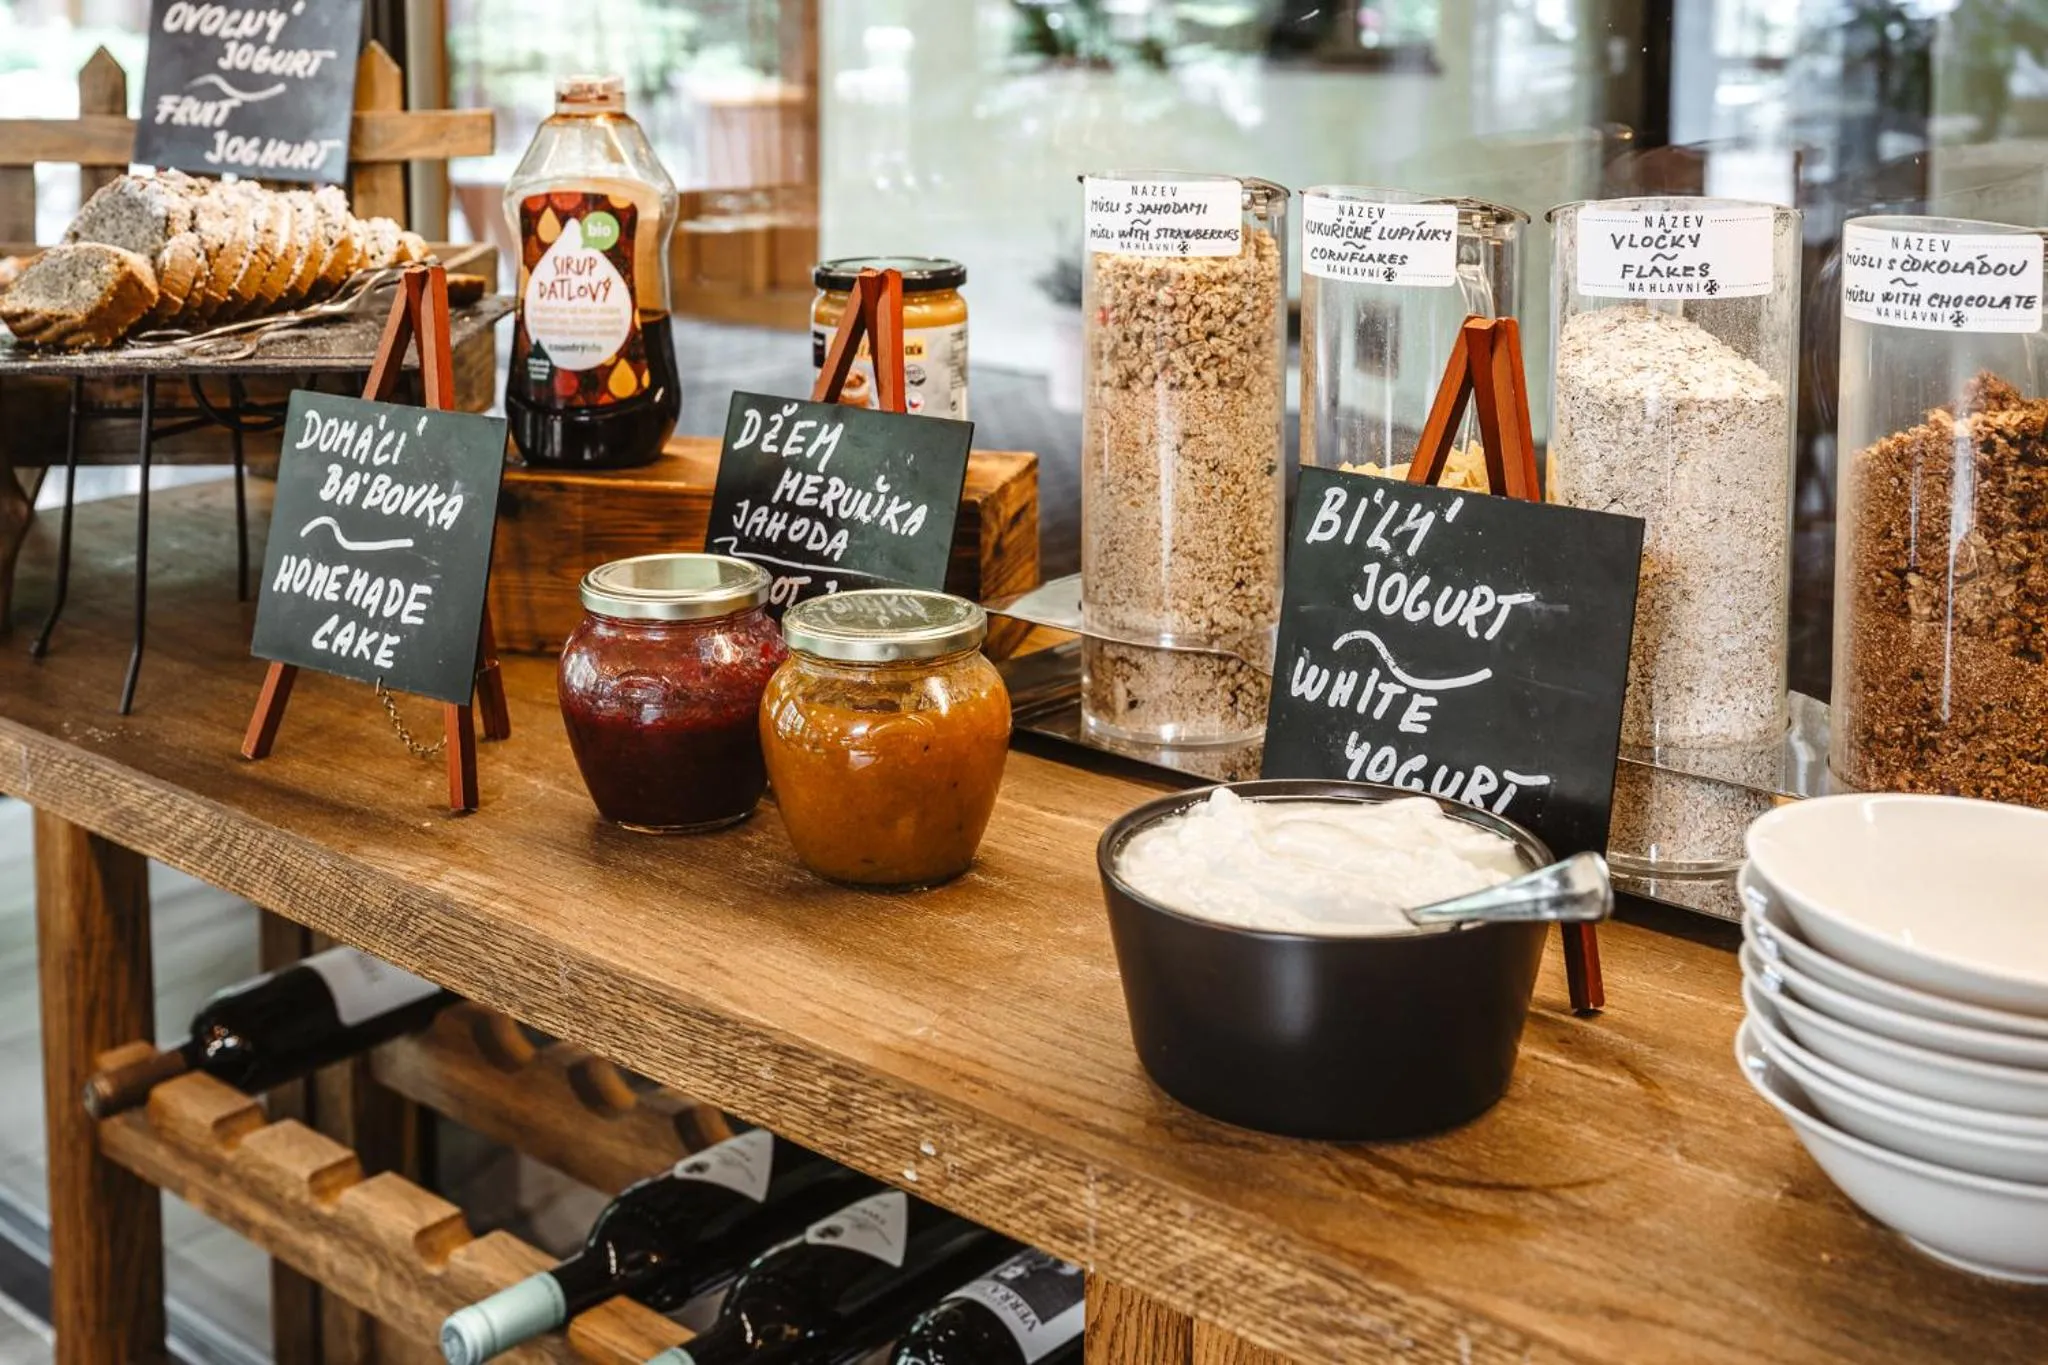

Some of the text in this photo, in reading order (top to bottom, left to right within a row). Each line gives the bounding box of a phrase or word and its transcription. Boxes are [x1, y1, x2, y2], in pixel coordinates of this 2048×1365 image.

[217, 40, 337, 78] JOGURT
[154, 95, 242, 128] FRUIT
[204, 130, 342, 170] JOGHURT
[1124, 202, 1133, 215] S
[1136, 202, 1208, 216] JAHODAMI
[1644, 213, 1704, 229] NÁZEV
[587, 220, 612, 238] bio
[1118, 226, 1150, 242] WITH
[1377, 220, 1452, 242] LUPÍNKY
[1611, 228, 1701, 250] VLOČKY
[553, 255, 598, 276] SIRUP
[1310, 247, 1408, 266] CORNFLAKES
[1621, 262, 1711, 279] FLAKES
[1887, 257, 1898, 272] S
[1628, 281, 1700, 294] NA HLAVNÍ
[1881, 291, 1922, 308] WITH
[1927, 292, 2037, 310] CHOCOLATE
[295, 409, 428, 466] DOMÁCÍ
[733, 402, 844, 473] DŽEM
[319, 463, 464, 530] BÁBOVKA
[772, 467, 928, 536] MERUŇKA
[732, 500, 850, 562] JAHODA
[1306, 486, 1464, 556] BÍLÝ
[272, 555, 432, 625] HOMEMADE
[770, 576, 811, 608] OT
[1353, 562, 1536, 641] JOGURT
[311, 614, 400, 669] CAKE
[1290, 655, 1438, 734] WHITE
[1345, 731, 1550, 815] YOGURT
